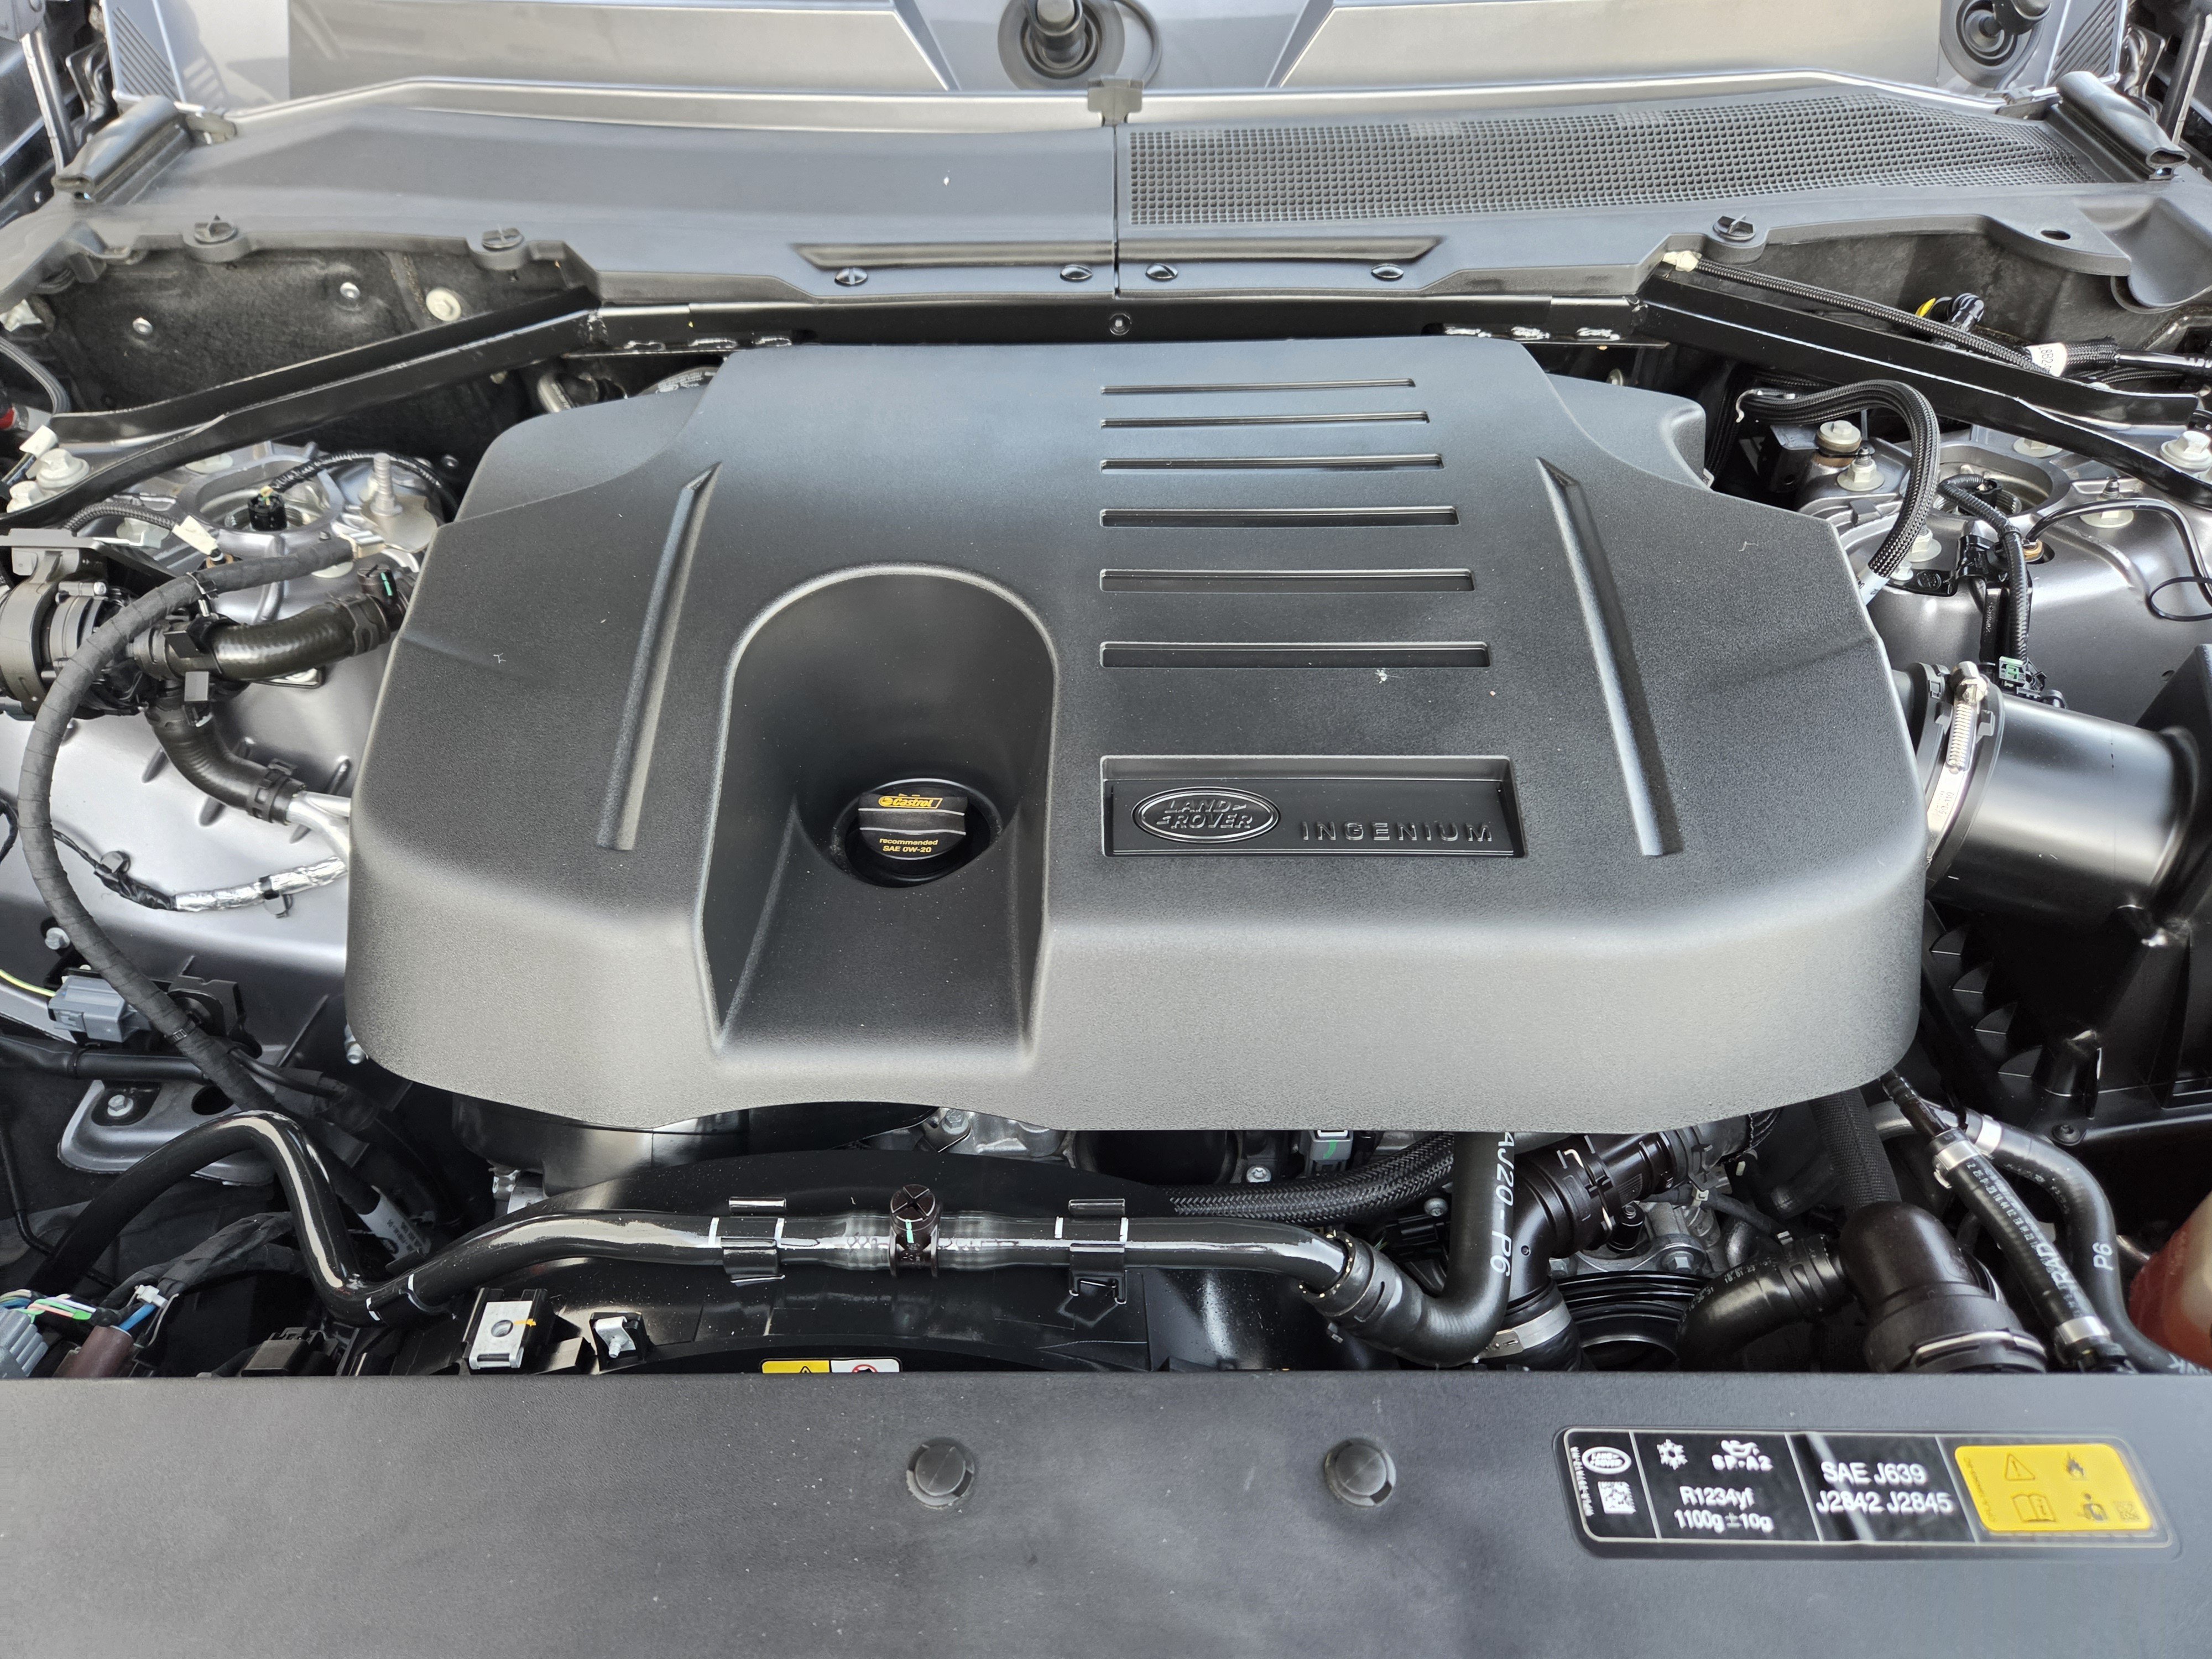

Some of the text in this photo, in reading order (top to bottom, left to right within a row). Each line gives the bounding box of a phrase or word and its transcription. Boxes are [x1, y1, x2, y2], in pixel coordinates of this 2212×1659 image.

[892, 797, 933, 807] Castrol
[1164, 799, 1232, 813] LAND
[1170, 813, 1253, 830] ROVER
[1301, 821, 1493, 842] INGENIUM
[2036, 1243, 2076, 1285] RAD
[2093, 1242, 2114, 1271] P6
[1820, 1461, 1928, 1485] SAE J639
[1679, 1485, 1755, 1511] R1234yf
[1815, 1490, 1954, 1515] J2842 J2845
